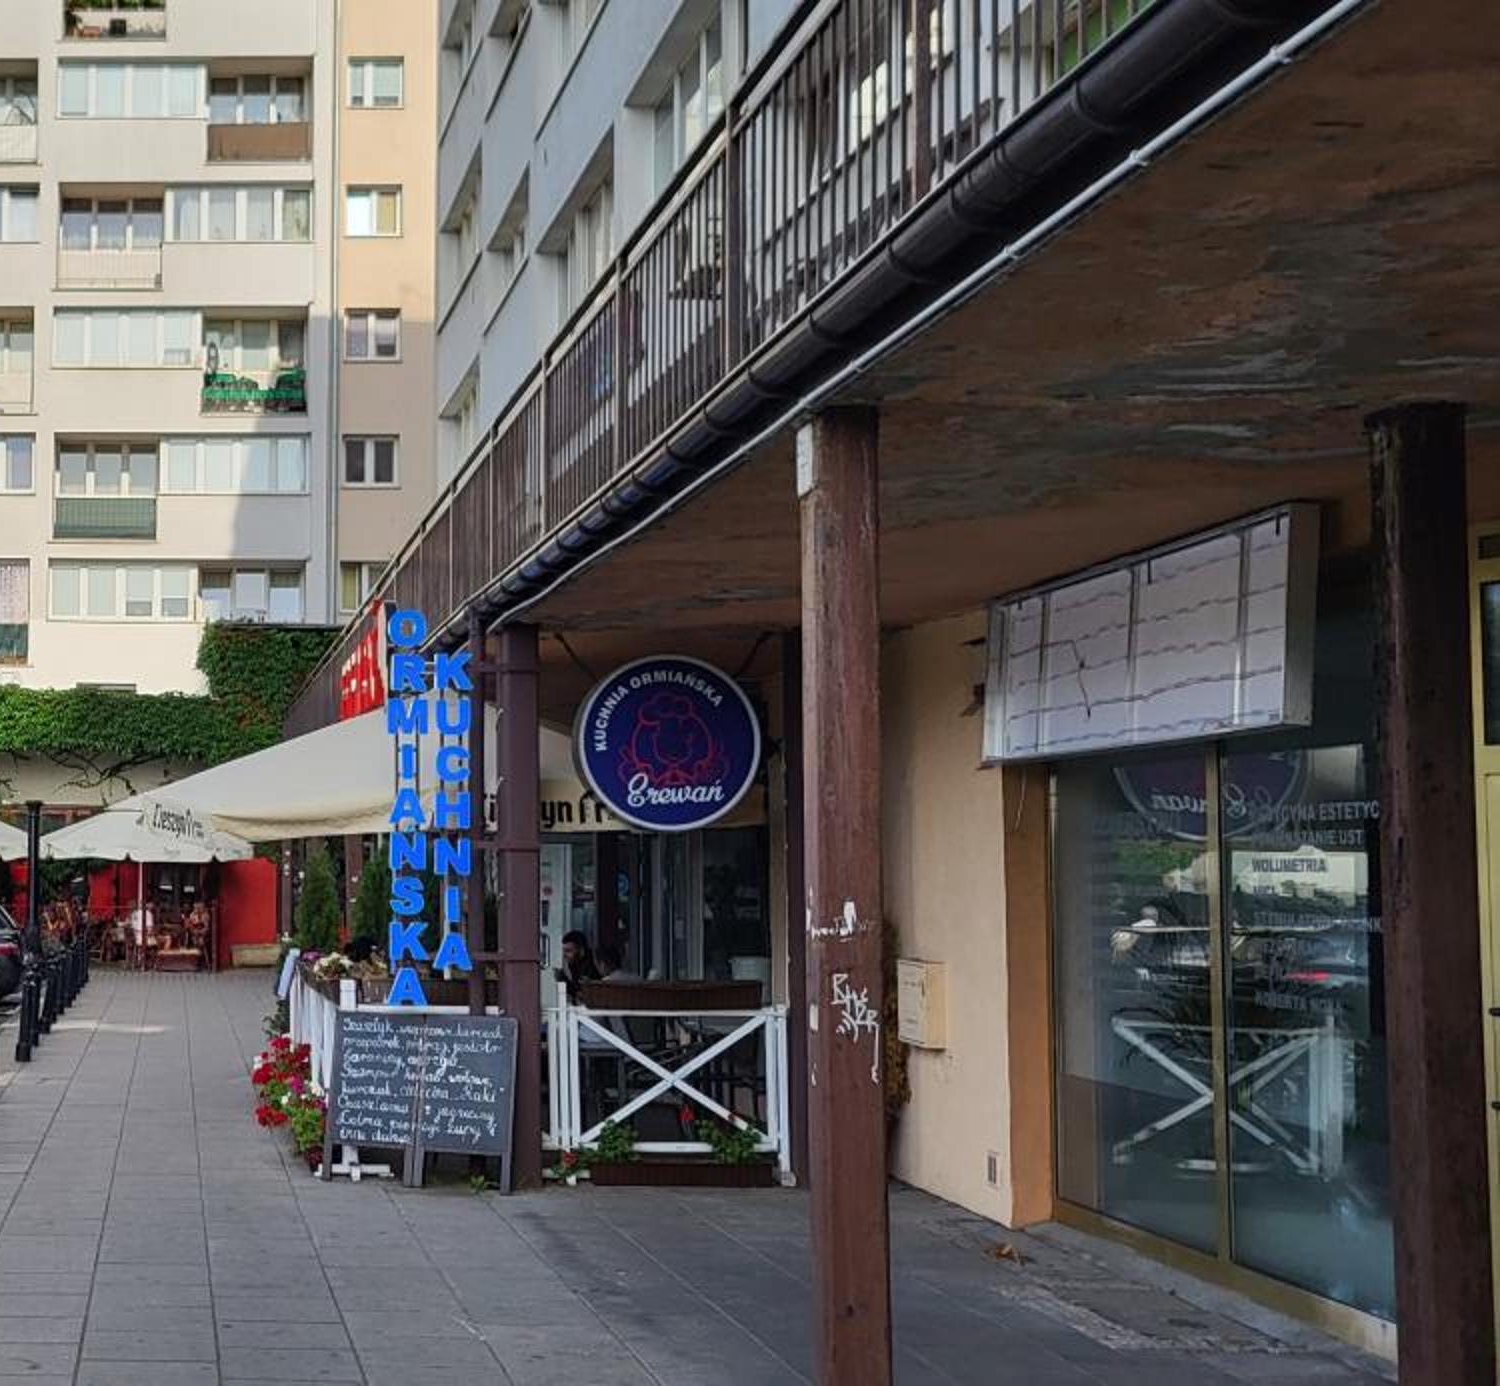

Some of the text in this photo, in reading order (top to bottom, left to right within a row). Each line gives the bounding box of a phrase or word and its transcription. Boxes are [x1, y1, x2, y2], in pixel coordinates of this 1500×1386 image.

[594, 669, 724, 752] KUCHNIA ORMIAŃSKA
[433, 652, 474, 971] KUCHNIA
[626, 771, 725, 808] Erewań
[1252, 857, 1328, 873] WOLUMETRIA
